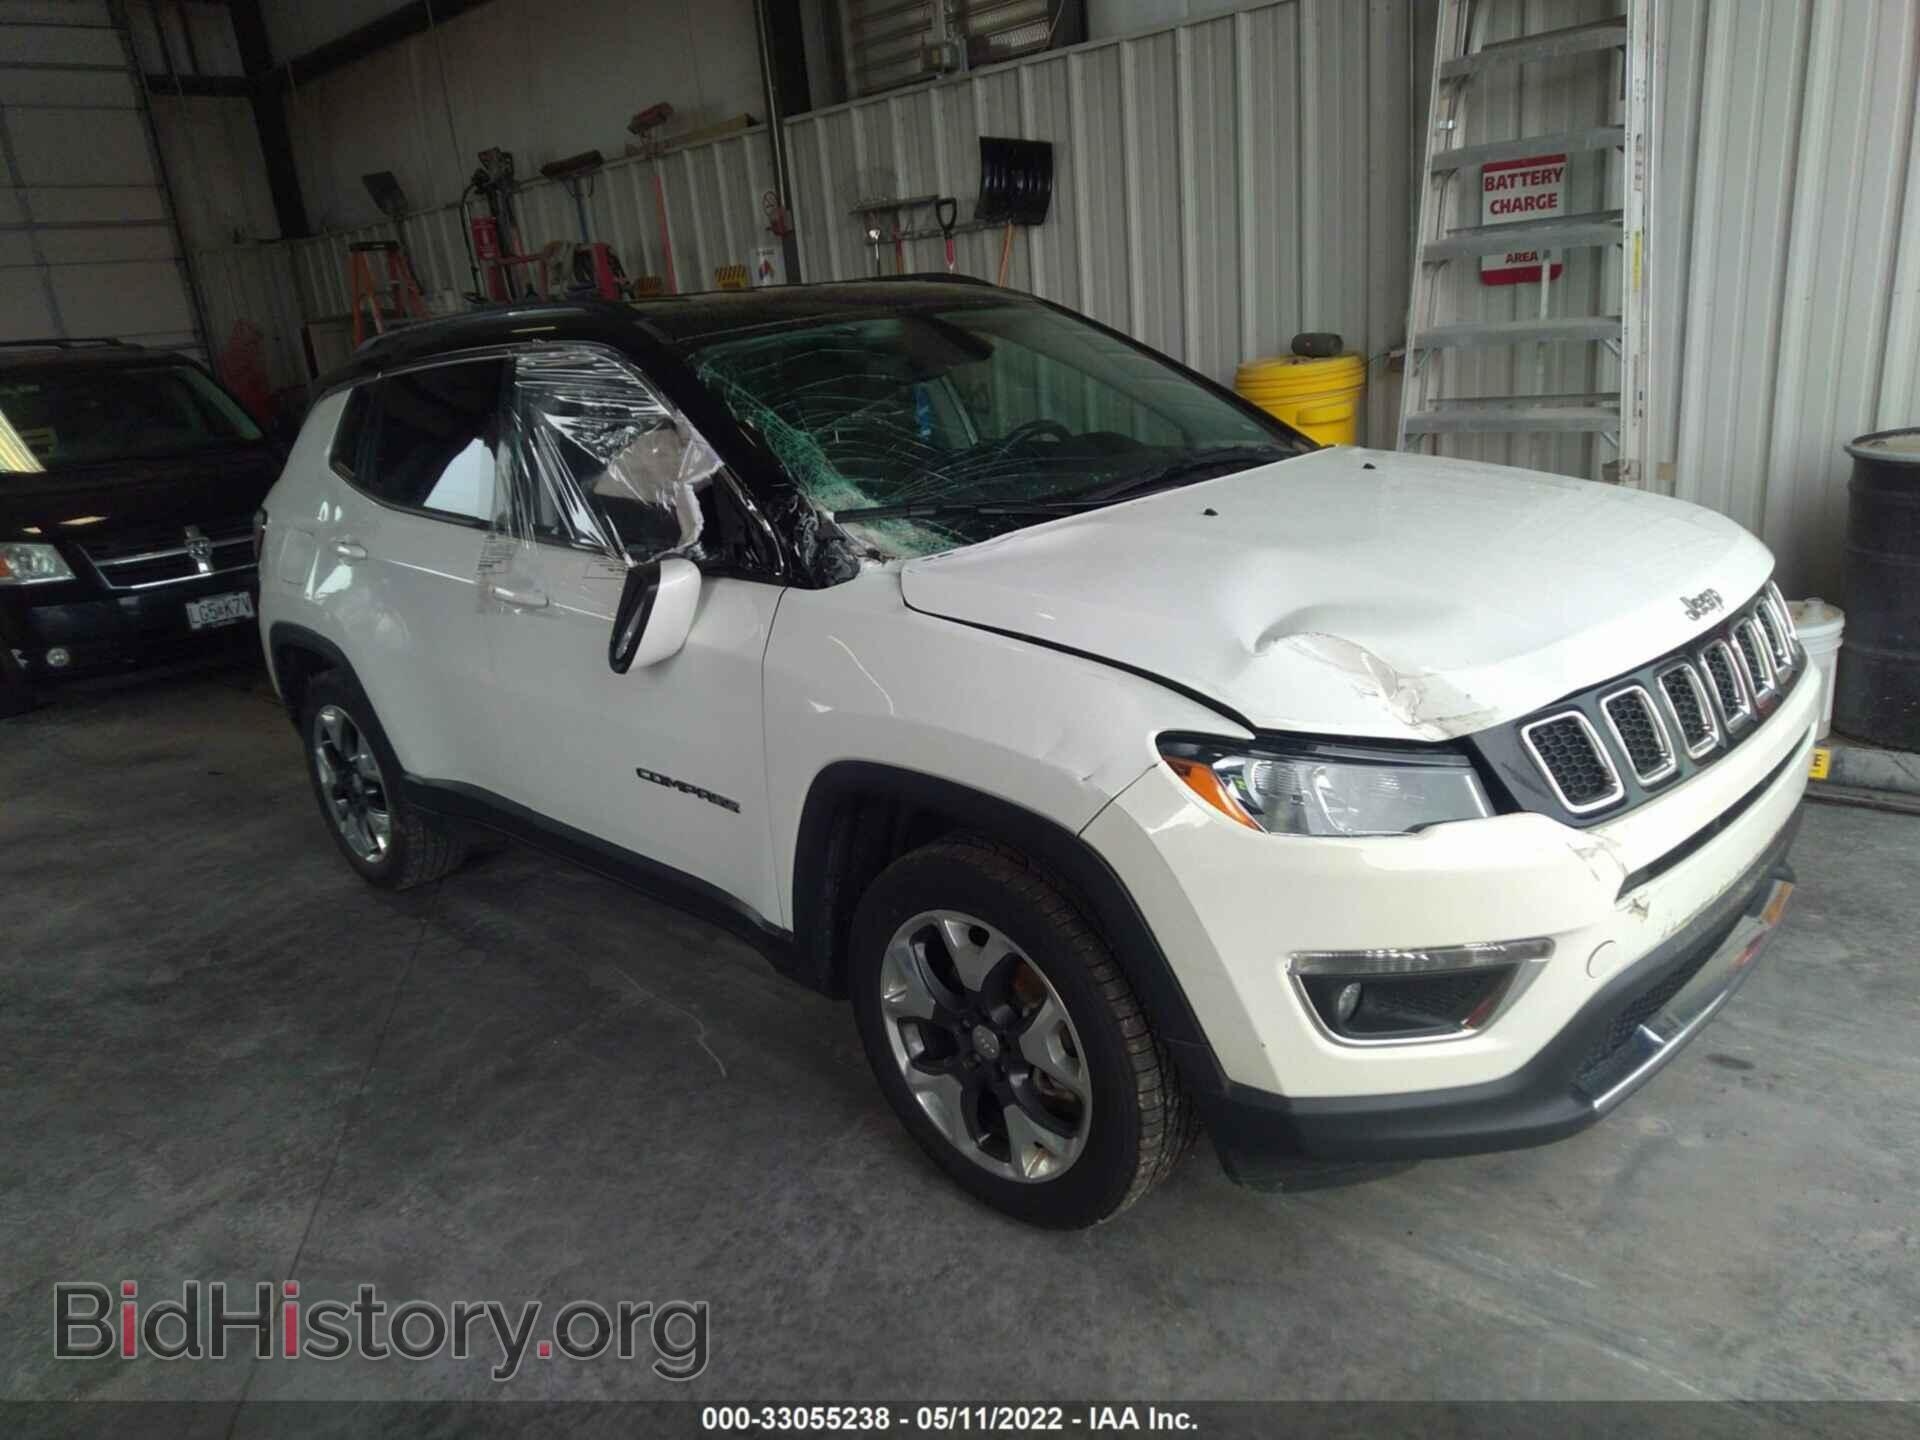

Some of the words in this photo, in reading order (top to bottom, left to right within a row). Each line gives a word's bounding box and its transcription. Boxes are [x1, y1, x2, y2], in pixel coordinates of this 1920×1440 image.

[1484, 166, 1564, 192] BATTERY
[1489, 192, 1558, 215] CHARGE
[1505, 250, 1539, 264] AREA
[1679, 588, 1724, 621] Jeep
[636, 767, 741, 814] COMPASS
